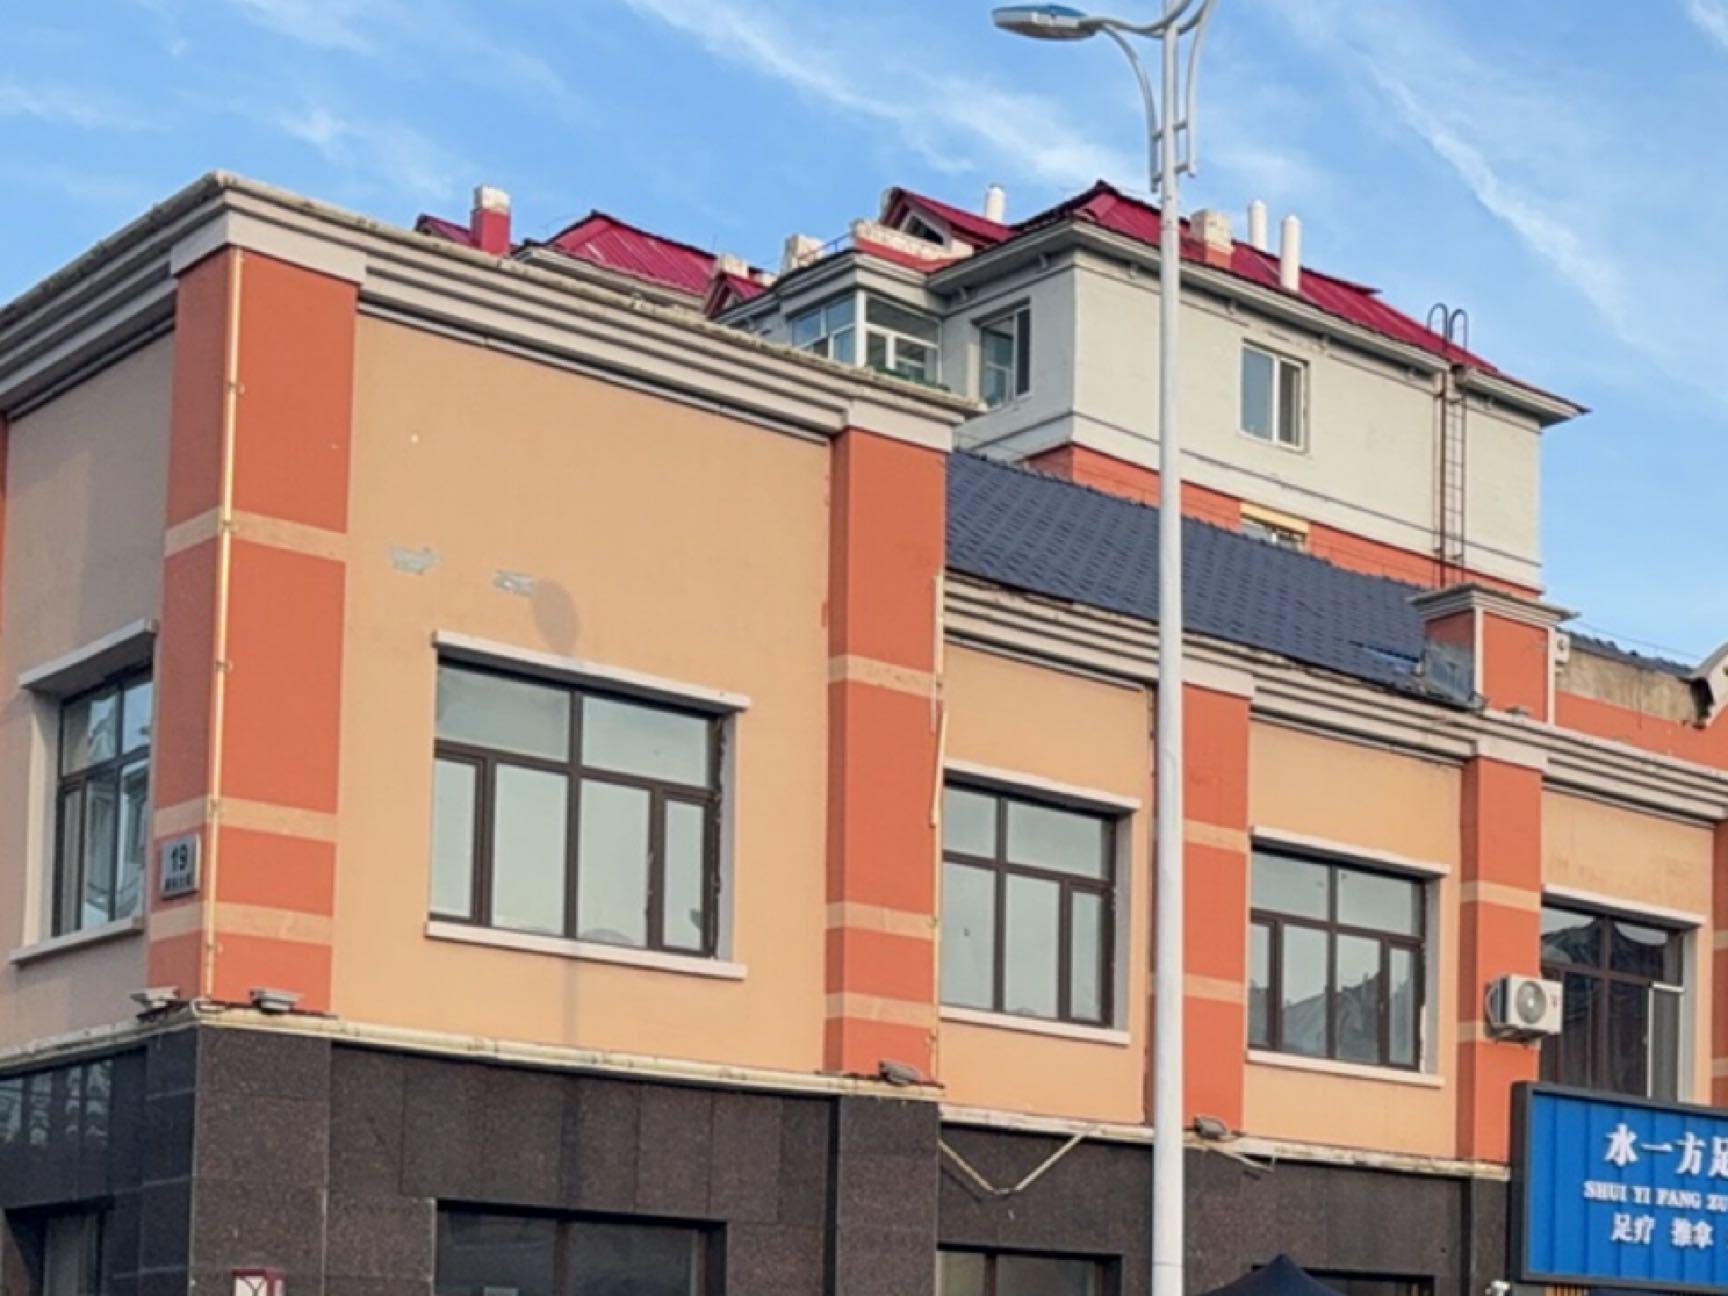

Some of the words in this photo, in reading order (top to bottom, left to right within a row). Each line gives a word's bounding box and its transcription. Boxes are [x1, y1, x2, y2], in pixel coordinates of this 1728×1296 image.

[171, 843, 188, 872] 19
[1583, 1180, 1628, 1203] SHUI
[1632, 1185, 1651, 1205] YI
[1656, 1187, 1701, 1210] FANG
[1705, 1193, 1728, 1213] ZU
[1610, 1211, 1656, 1245] 足疗
[1670, 1216, 1714, 1249] 推拿
